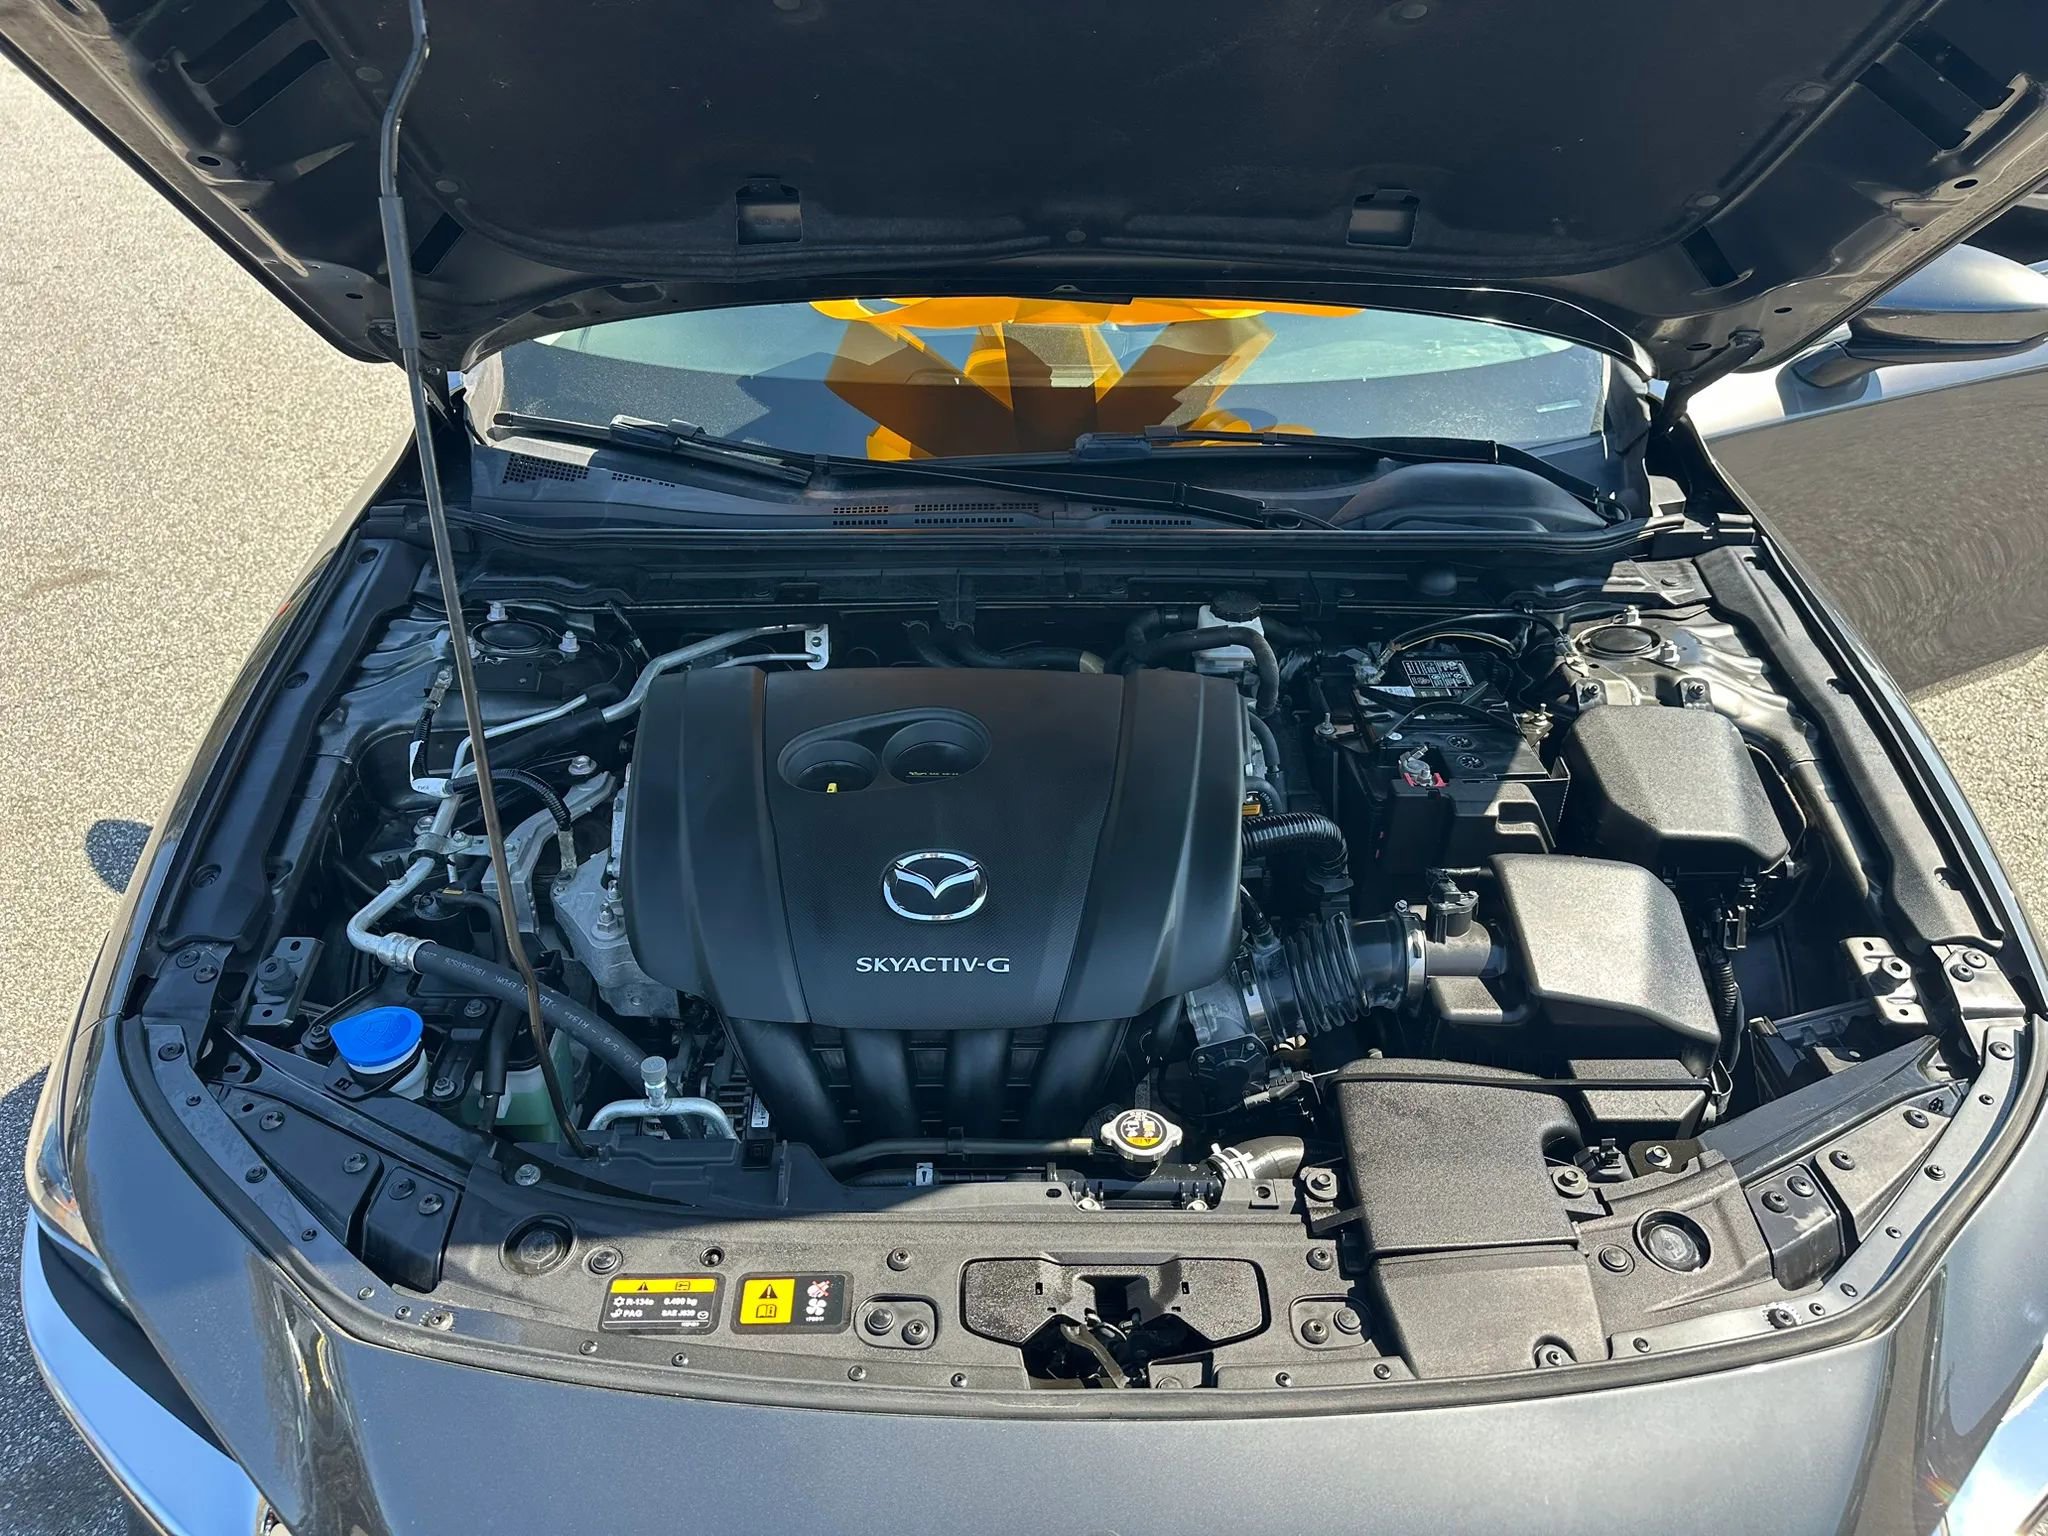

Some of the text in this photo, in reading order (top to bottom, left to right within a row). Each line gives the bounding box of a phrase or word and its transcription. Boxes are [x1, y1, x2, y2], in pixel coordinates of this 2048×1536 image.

[855, 956, 1010, 973] SKYACTIV-G
[625, 1297, 655, 1306] R-134a
[622, 1309, 643, 1318] PAG
